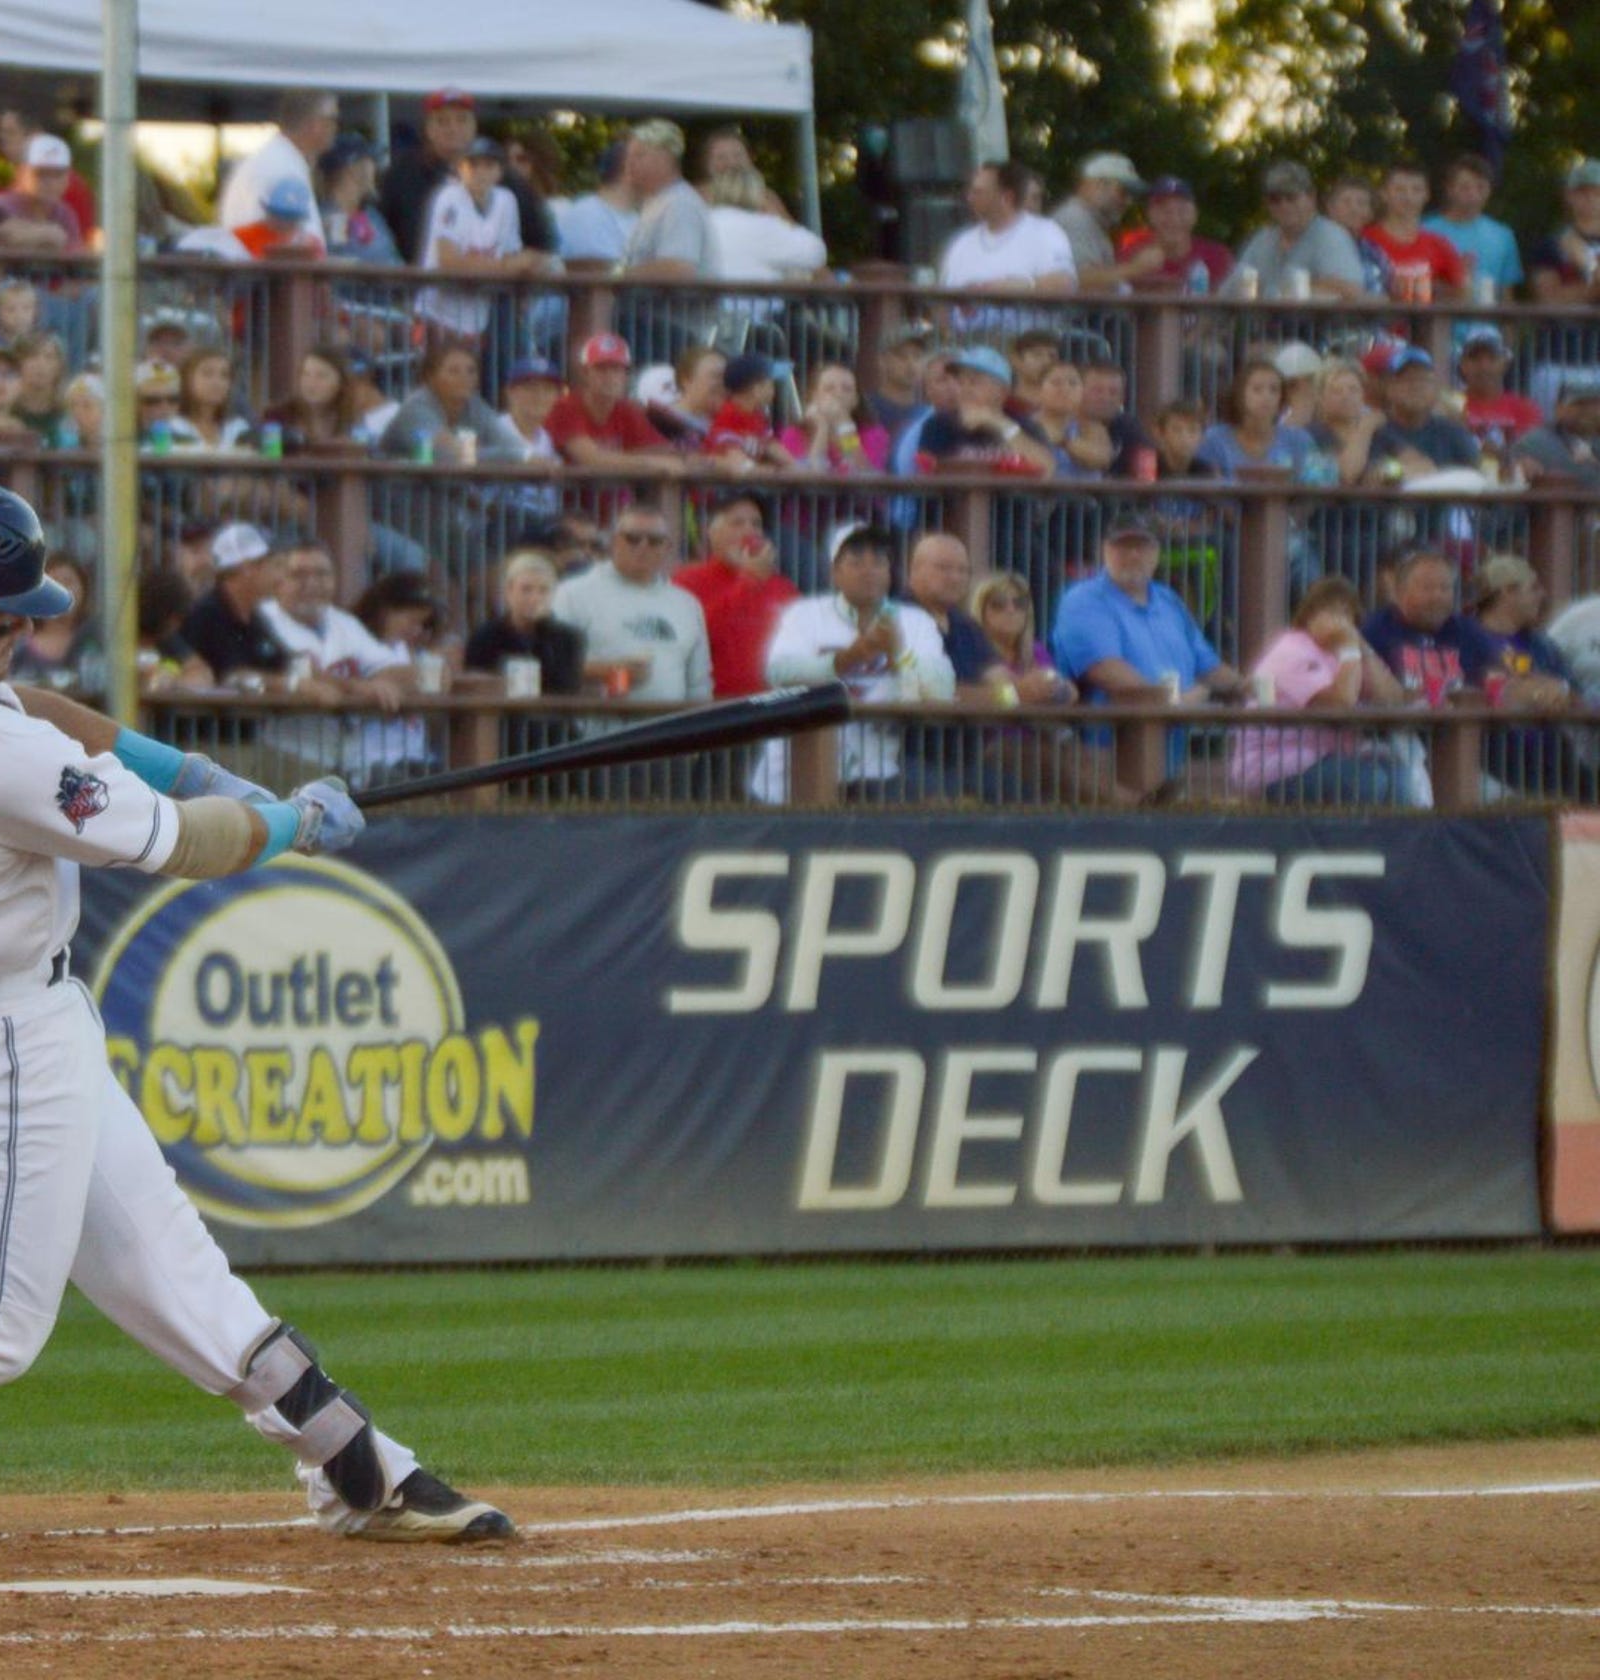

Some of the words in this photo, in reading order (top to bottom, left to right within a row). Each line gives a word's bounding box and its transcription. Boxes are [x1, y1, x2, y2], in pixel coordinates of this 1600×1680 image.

[195, 950, 400, 1027] Outlet
[669, 850, 1386, 1012] SPORTS
[410, 1155, 530, 1206] .com
[797, 1047, 1261, 1210] DECK
